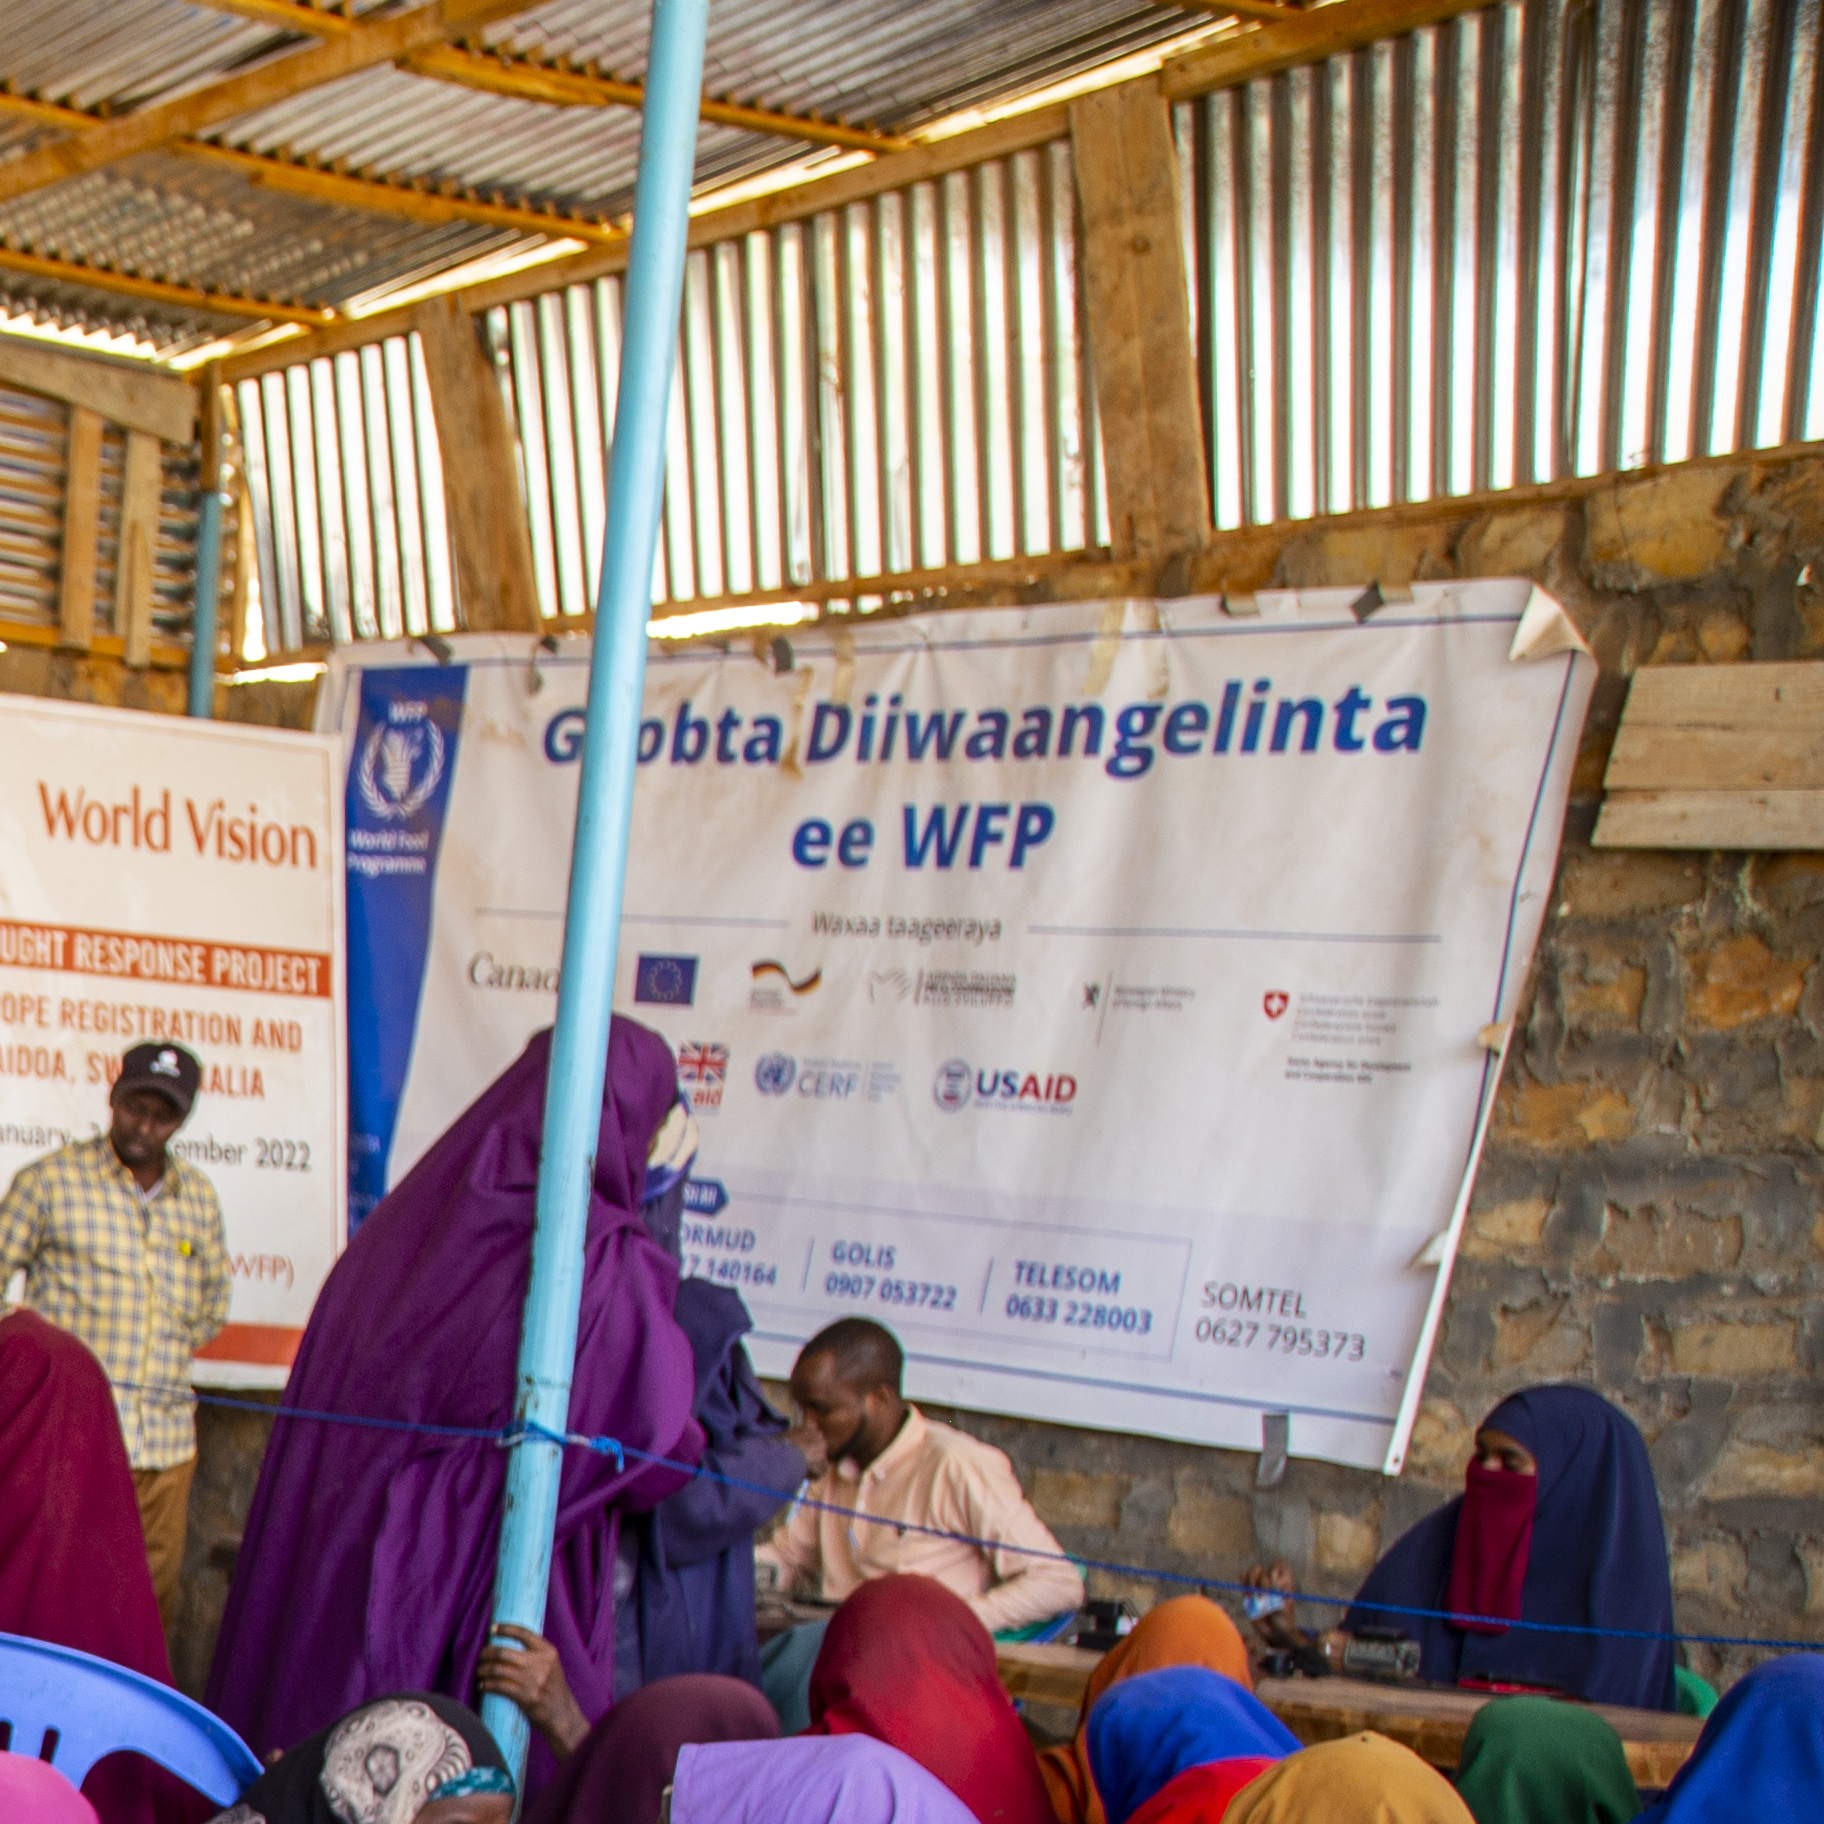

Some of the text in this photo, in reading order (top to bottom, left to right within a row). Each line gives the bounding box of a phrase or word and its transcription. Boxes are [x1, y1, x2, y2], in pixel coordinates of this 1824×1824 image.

[389, 701, 428, 721] WFP
[543, 680, 1428, 781] Gobta Diiwaangelinta
[37, 781, 317, 869] World Vision
[791, 804, 1056, 871] ee WFP
[811, 912, 1002, 944] Waxaa taageeraya
[75, 932, 205, 984] RESPONSE
[213, 950, 322, 993] PROJECT
[468, 951, 560, 993] Cana
[61, 1002, 241, 1049] REGISTRATION
[252, 1020, 303, 1053] AND
[202, 1064, 266, 1100] ALIA
[797, 1070, 858, 1100] CERF
[976, 1067, 1077, 1103] USAID
[171, 1133, 247, 1163] ember
[256, 1137, 312, 1172] 2022
[682, 1224, 756, 1252] ORMUD
[831, 1240, 897, 1269] GOLIS
[228, 1255, 295, 1291] WFP)
[708, 1257, 778, 1286] 140164
[1014, 1260, 1122, 1294] TELESOM
[826, 1272, 957, 1311] 0907 053722
[1202, 1281, 1307, 1319] SOMTEL
[1007, 1293, 1153, 1335] 0633 228003
[1196, 1316, 1366, 1361] 0627 795373
